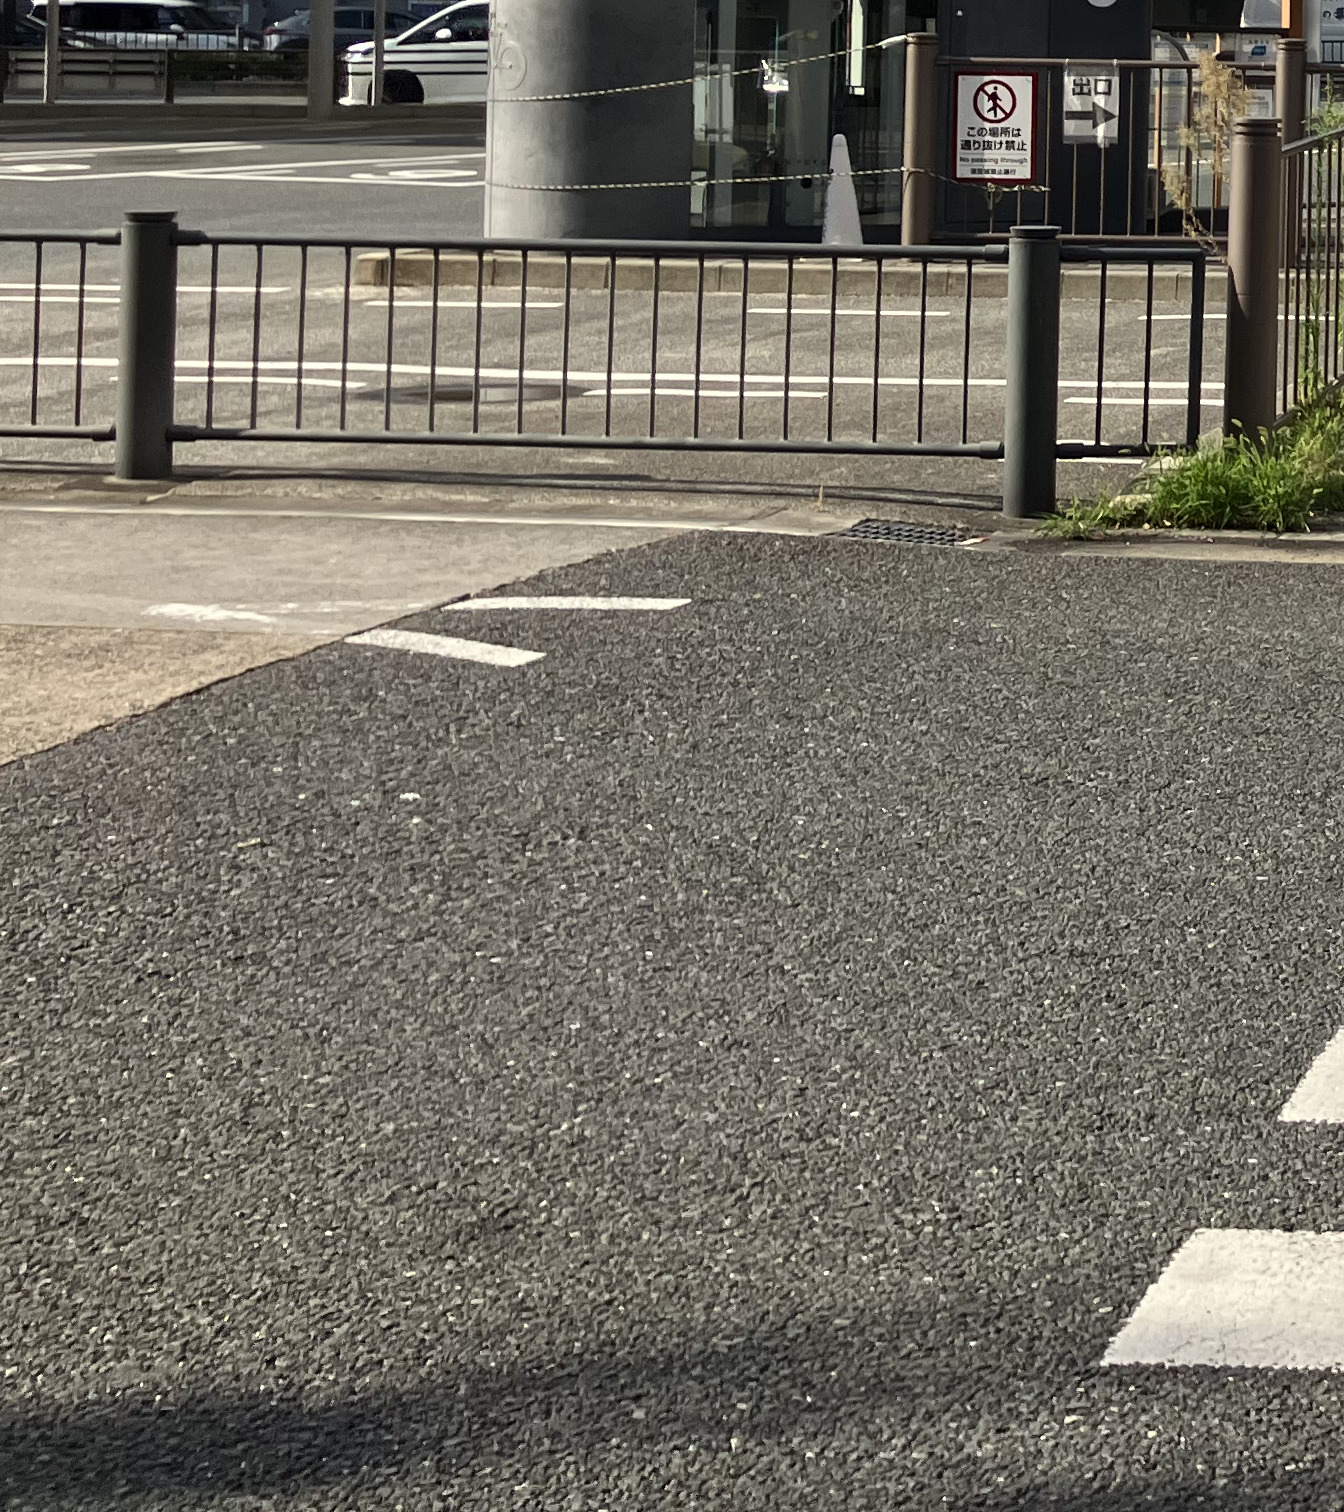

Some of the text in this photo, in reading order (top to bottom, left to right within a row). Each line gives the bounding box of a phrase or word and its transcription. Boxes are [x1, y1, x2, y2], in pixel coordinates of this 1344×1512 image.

[1072, 78, 1112, 96] 出口
[967, 127, 1021, 137] この場所は
[960, 140, 1027, 151] 通り抜け禁止
